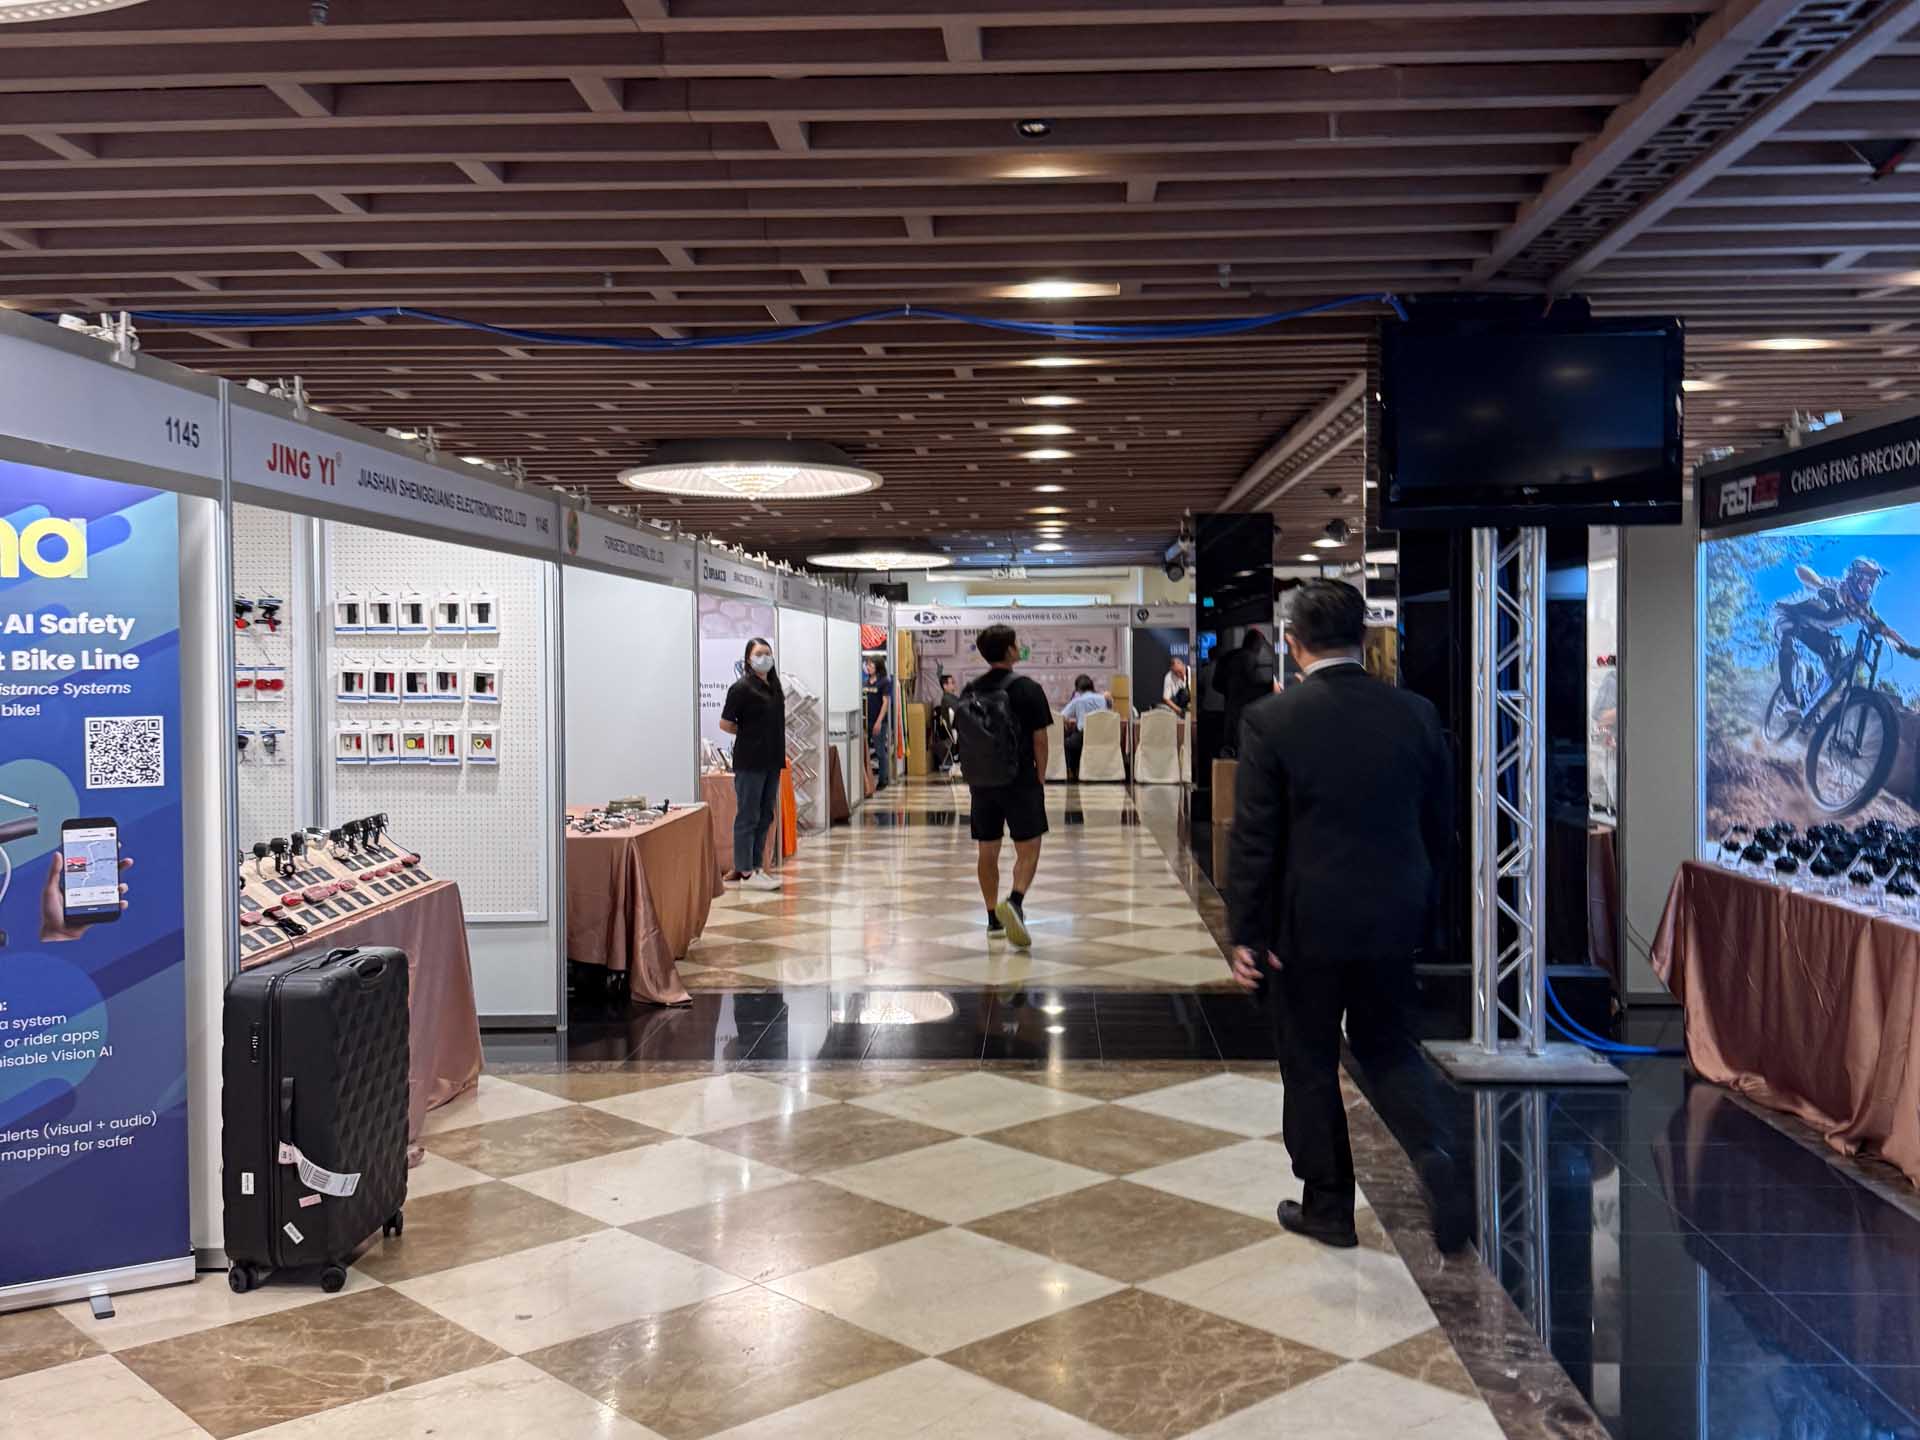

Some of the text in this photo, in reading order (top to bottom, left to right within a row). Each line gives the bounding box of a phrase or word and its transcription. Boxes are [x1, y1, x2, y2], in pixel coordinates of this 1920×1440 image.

[165, 416, 200, 449] 1145
[266, 442, 337, 487] JING YI
[1791, 463, 1828, 494] CHENG
[1829, 455, 1859, 485] FENG
[357, 467, 398, 495] JIASHAN
[0, 611, 136, 641] AI Safety
[11, 647, 76, 671] Bike
[80, 647, 140, 671] Line
[63, 682, 132, 698] Systems
[1, 703, 41, 717] bike!
[12, 1014, 67, 1032] system
[4, 1029, 100, 1049] or rider apps
[51, 1047, 95, 1062] Vision
[99, 1045, 113, 1057] AI
[0, 1128, 39, 1143] alerts
[43, 1121, 92, 1139] (visual
[109, 1111, 157, 1129] audio)
[1, 1134, 135, 1162] mapping for safer
